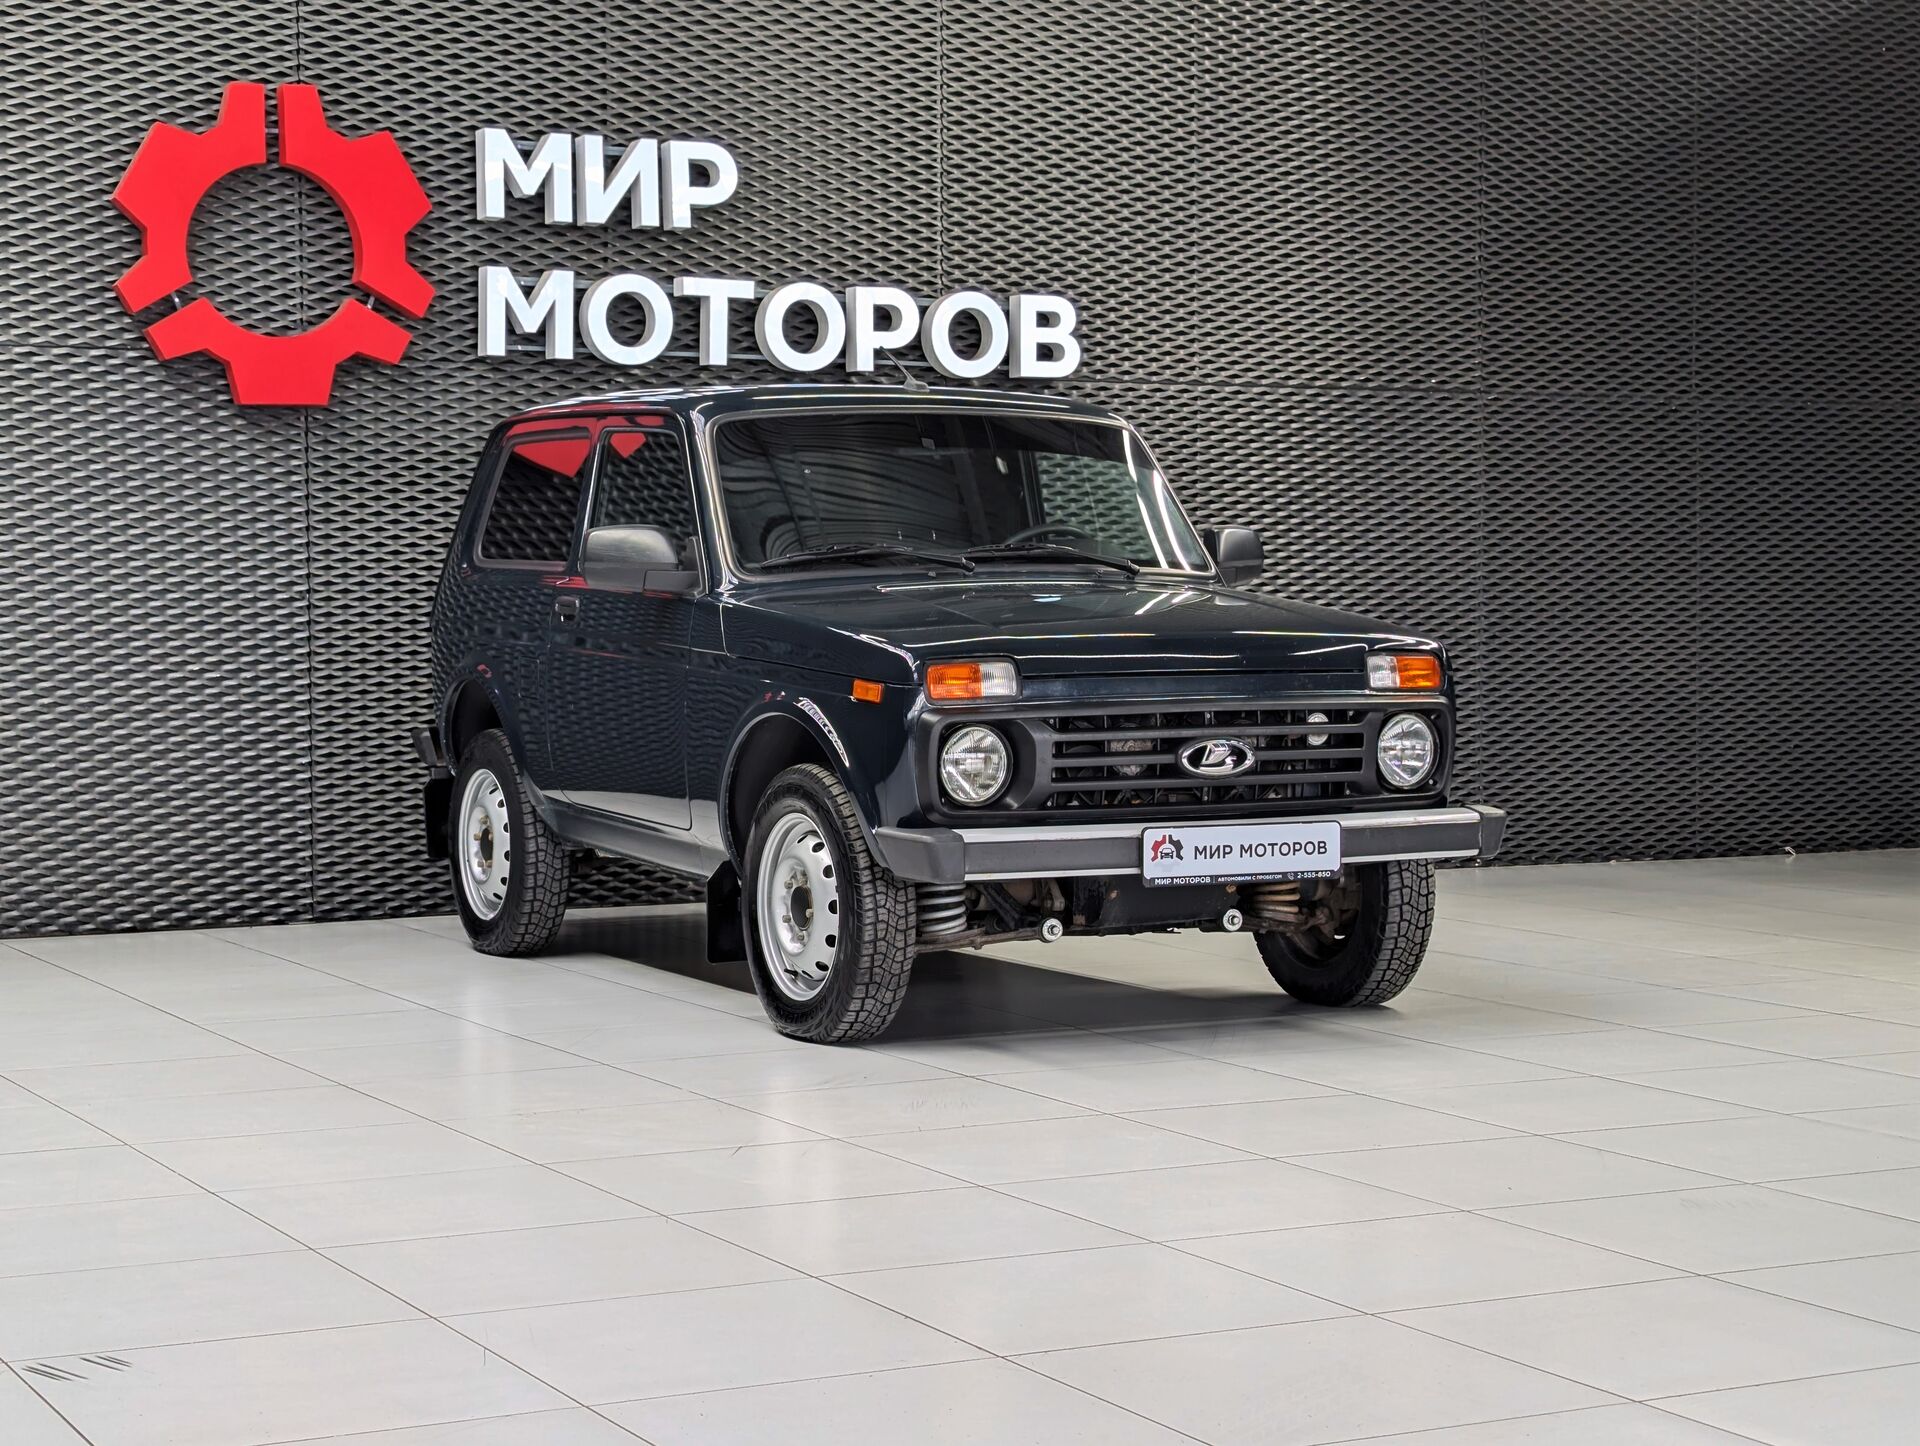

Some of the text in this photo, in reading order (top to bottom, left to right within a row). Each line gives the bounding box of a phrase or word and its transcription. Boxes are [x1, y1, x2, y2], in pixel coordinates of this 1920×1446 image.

[475, 127, 739, 231] МИР
[477, 265, 1082, 379] МОТОРОВ
[1173, 876, 1211, 884] МОТОРОВ
[1194, 841, 1328, 860] МИР МОТОРОВ
